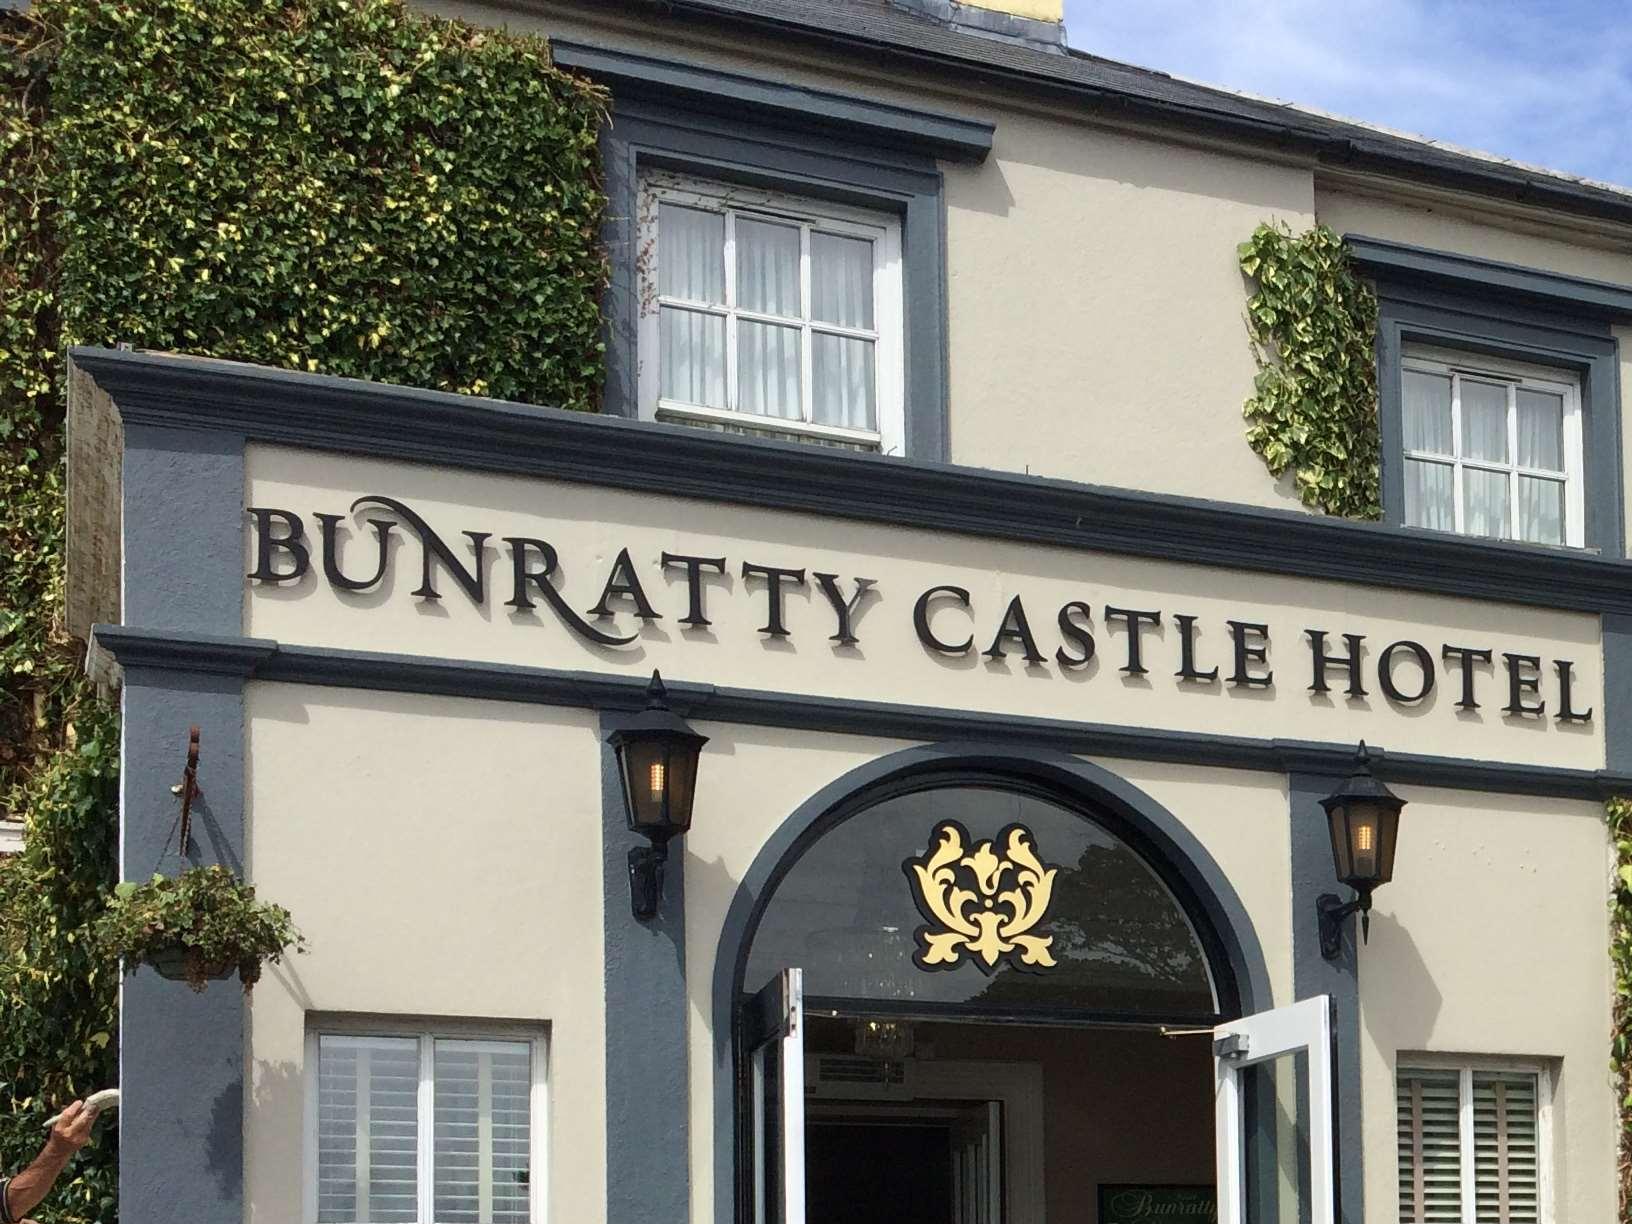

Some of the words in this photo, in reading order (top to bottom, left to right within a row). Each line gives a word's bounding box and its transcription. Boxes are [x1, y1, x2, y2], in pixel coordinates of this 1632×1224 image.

[246, 495, 878, 645] BUNRATTY
[913, 585, 1273, 688] CASTLE
[1304, 628, 1593, 723] HOTEL
